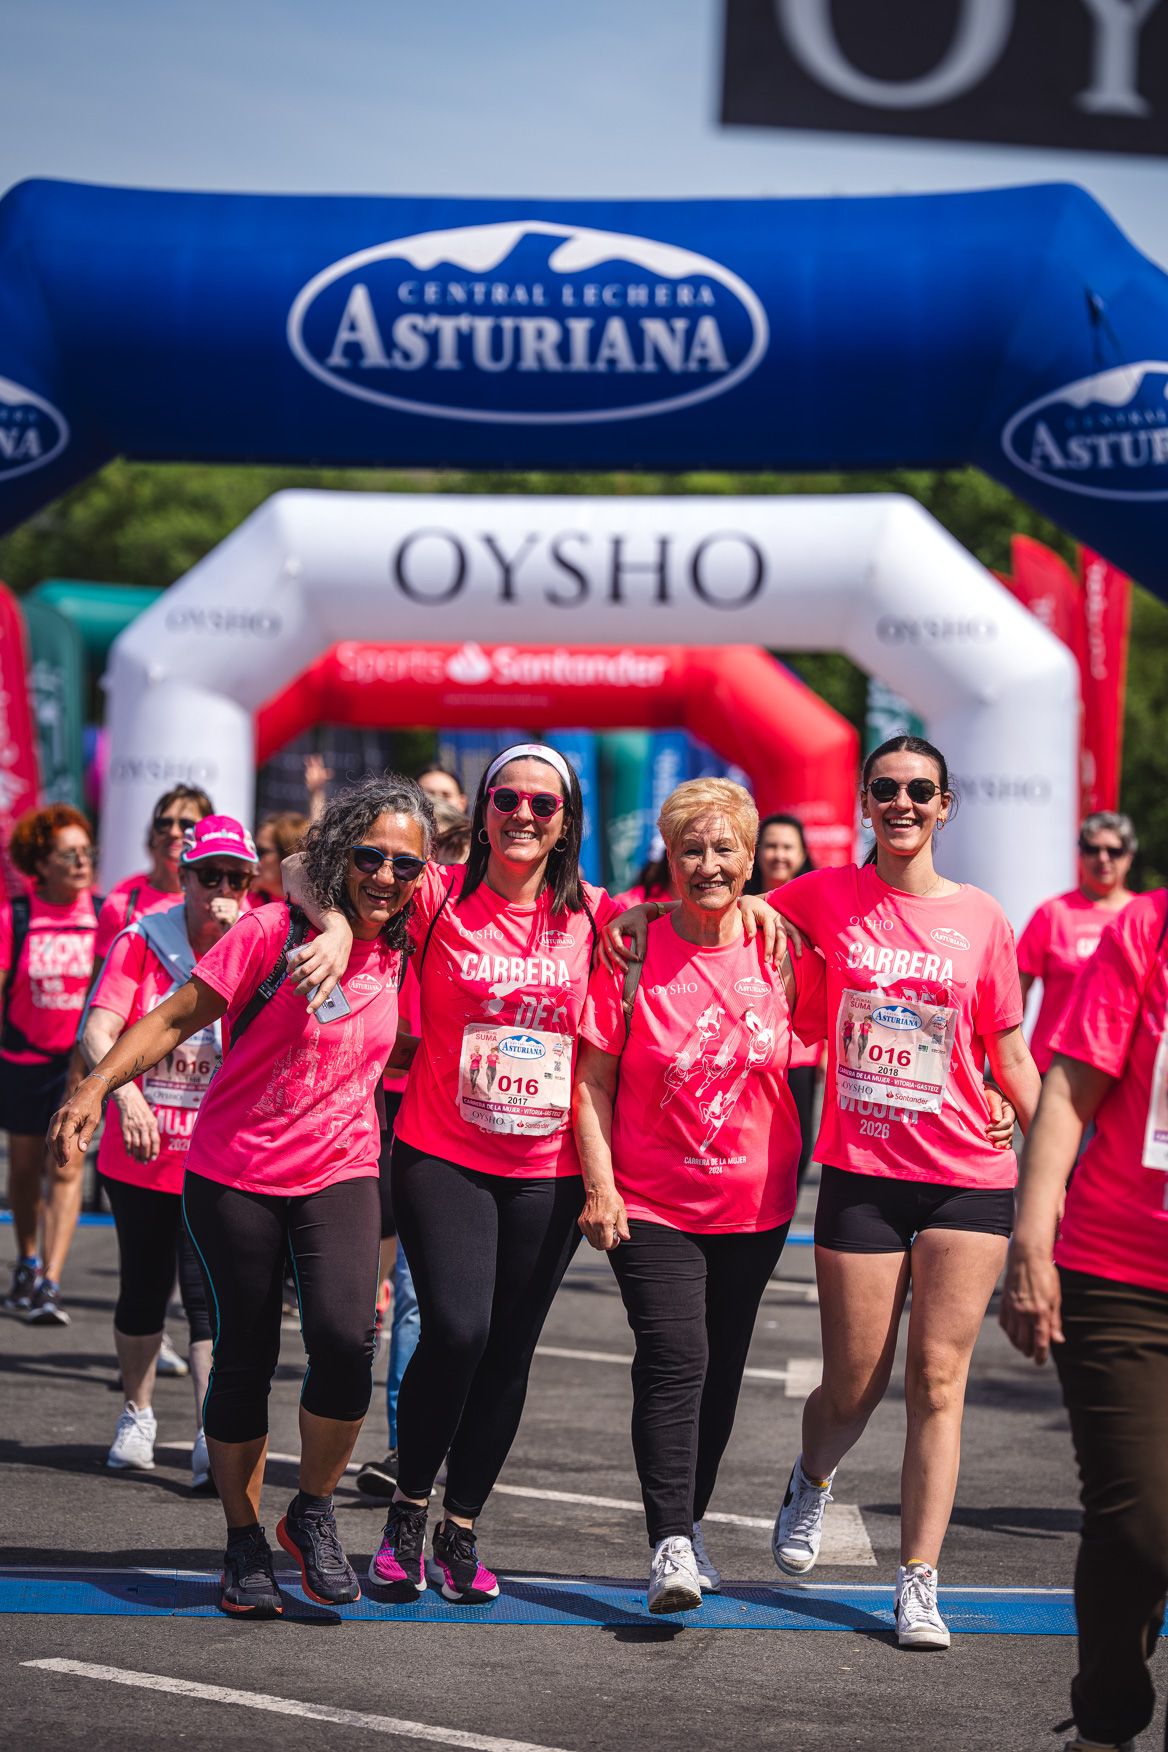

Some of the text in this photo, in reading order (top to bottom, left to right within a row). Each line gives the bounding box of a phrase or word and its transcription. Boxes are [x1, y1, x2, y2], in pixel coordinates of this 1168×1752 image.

[397, 280, 716, 307] CENTRAL LECHERA
[325, 281, 731, 374] ASTURIANA
[389, 525, 769, 612] OYSHO
[492, 645, 670, 688] Santander
[459, 928, 504, 940] OYSHO
[933, 931, 968, 949] ASTURIANA
[460, 952, 571, 988] CARRERA
[846, 941, 953, 986] CARRERA
[651, 982, 698, 996] OYSHO
[850, 1000, 871, 1011] SUMA
[875, 1010, 918, 1028] ASTURIANA
[475, 1033, 498, 1042] SUMA
[501, 1041, 543, 1056] ASTURIANA
[868, 1044, 912, 1067] 016
[175, 1060, 210, 1074] 016
[878, 1066, 899, 1077] 2018
[497, 1075, 539, 1096] 016
[871, 1075, 891, 1084] MUJER
[842, 1080, 874, 1095] OYSHO
[507, 1096, 528, 1106] 2017
[894, 1093, 929, 1105] Santander
[471, 1109, 505, 1126] OYSHO
[502, 1106, 520, 1114] MUJER
[859, 1119, 890, 1139] 2026
[684, 1155, 747, 1166] CARRERA DE LA MUJER
[708, 1166, 723, 1175] 2024
